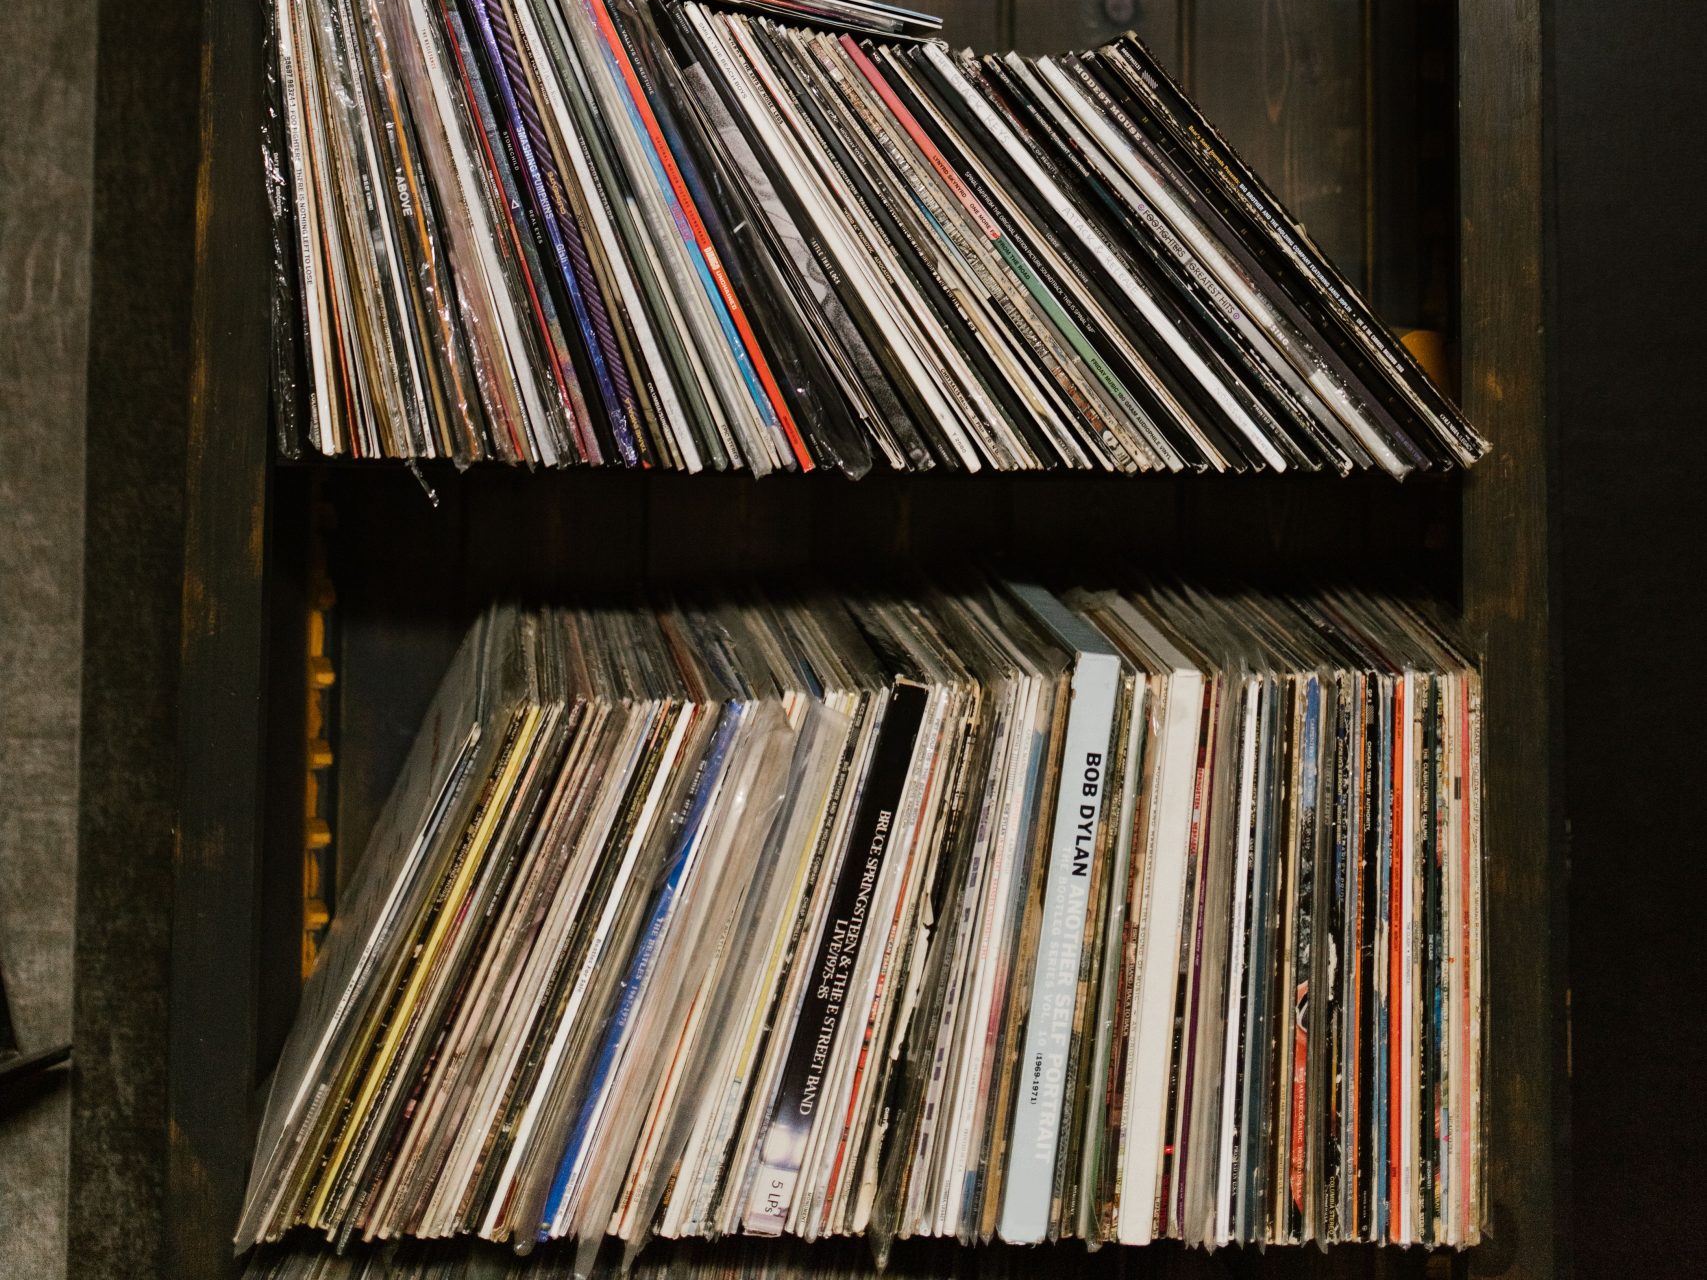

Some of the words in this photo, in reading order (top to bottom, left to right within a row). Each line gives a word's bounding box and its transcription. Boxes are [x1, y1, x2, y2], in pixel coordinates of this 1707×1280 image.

[521, 35, 531, 51] CASH
[619, 29, 637, 57] VALLEYS
[632, 56, 642, 67] OF
[637, 66, 655, 95] NEPTUNE
[697, 20, 714, 42] SMILE
[711, 43, 723, 58] THE
[719, 56, 737, 81] BEACH
[733, 80, 748, 100] BOYS
[289, 109, 297, 126] FOO
[1073, 62, 1112, 106] MODEST
[1109, 104, 1143, 141] MOUSE
[291, 126, 300, 161] FIGHTERS
[949, 71, 985, 112] BLACK
[983, 113, 1011, 144] KEYS
[1060, 205, 1095, 244] ATTACK
[295, 168, 303, 192] THERE
[502, 130, 520, 171] STONECHILD
[527, 208, 537, 225] REAL
[533, 227, 543, 245] EYES
[547, 171, 567, 215] CURRENTS
[577, 135, 591, 161] THOSE
[587, 161, 599, 182] POOR
[596, 182, 614, 220] BASTARDS
[298, 193, 304, 201] IS
[394, 174, 412, 217] ABOVE
[515, 125, 538, 172] SMASHING
[531, 172, 554, 220] PUMPKINS
[555, 242, 568, 264] Gish
[298, 202, 307, 235] NOTHING
[931, 154, 949, 175] LYNYRD
[946, 173, 967, 198] SKYNYRD
[968, 202, 980, 215] ONE
[977, 213, 992, 230] MORE
[996, 238, 1011, 255] FROM
[1008, 254, 1018, 265] THE
[1016, 264, 1031, 280] ROAD
[857, 230, 874, 254] YANKOVIC
[963, 170, 979, 188] SPINAL
[991, 206, 1001, 216] THE
[997, 214, 1016, 235] ORIGINAL
[1012, 233, 1029, 251] MOTION
[1025, 249, 1042, 268] PICTURE
[1038, 266, 1064, 296] SOUNDTRACK
[1072, 308, 1088, 326] SPINAL
[1045, 231, 1060, 248] LORDE
[1238, 182, 1248, 193] BIG
[1244, 190, 1264, 211] BROTHER
[1260, 209, 1271, 220] AND
[1268, 218, 1279, 229] THE
[1275, 226, 1294, 246] HOLDING
[1290, 244, 1311, 266] COMPANY
[1307, 263, 1330, 288] FEATURING
[1326, 285, 1340, 300] JANIS
[1337, 297, 1352, 313] JOPLIN
[303, 254, 310, 264] TO
[304, 265, 312, 285] LOSE
[820, 256, 832, 271] THAT
[828, 269, 841, 285] LOCK
[1141, 208, 1161, 229] FOO
[1155, 224, 1186, 259] FIGHTERS
[1186, 260, 1222, 299] GREATEST
[1217, 295, 1236, 315] HITS
[703, 246, 720, 271] DJANGO
[715, 269, 737, 311] UNCHAINED
[623, 397, 639, 430] IMPALA
[1089, 356, 1107, 377] FRIDAY
[1104, 375, 1120, 393] MUSIC
[1123, 400, 1138, 417] GRAM
[1134, 415, 1161, 446] AUDIOPHILE
[1157, 444, 1172, 461] VINYL
[634, 429, 647, 454] TAME
[721, 423, 731, 438] EPIC
[726, 437, 740, 460] STEREO
[931, 717, 940, 730] PET
[832, 772, 845, 800] BROTHER
[920, 767, 929, 780] THE
[1081, 752, 1101, 798] BOB
[1194, 767, 1203, 810] SPRINGSTEEN
[828, 800, 837, 815] AND
[914, 781, 926, 806] BEACH
[824, 815, 833, 828] THE
[869, 809, 891, 855] BRUCE
[910, 806, 920, 827] BOYS
[816, 828, 829, 855] HOLDING
[1072, 804, 1095, 878] DYLAN
[1190, 822, 1198, 857] NEBRASKA
[808, 856, 821, 886] COMPANY
[1058, 844, 1071, 872] THE
[798, 895, 809, 917] CHEAP
[843, 856, 879, 954] SPRINGSTEEN
[1050, 875, 1067, 937] BOOTLEG
[650, 915, 664, 938] THE
[1057, 883, 1085, 987] ANOTHER
[1138, 927, 1146, 957] SOUND
[587, 937, 602, 965] Beatles
[633, 938, 655, 981] BEATLES
[838, 954, 852, 969] &
[1044, 942, 1059, 989] SERIES
[1136, 962, 1142, 971] OF
[576, 977, 587, 994] Sale
[582, 965, 592, 978] For
[829, 969, 849, 1003] THE
[1133, 974, 1141, 1001] MUSIC
[616, 984, 638, 1027] 1967-1970
[825, 1003, 838, 1015] E
[1040, 995, 1052, 1024] VOL.
[1123, 1009, 1130, 1018] TO
[1124, 988, 1132, 1008] BACK
[1050, 993, 1072, 1045] SELF
[1130, 1020, 1137, 1034] AN
[810, 1015, 835, 1073] STREET
[1037, 1031, 1048, 1046] 10
[1126, 1036, 1135, 1078] ORIGINAL
[1029, 1052, 1043, 1105] (1969-1971)
[798, 1073, 819, 1117] BAND
[1034, 1052, 1063, 1164] PORTRAIT
[770, 1178, 784, 1190] 5
[763, 1192, 781, 1215] LPs
[799, 1191, 812, 1223] MONUMENT
